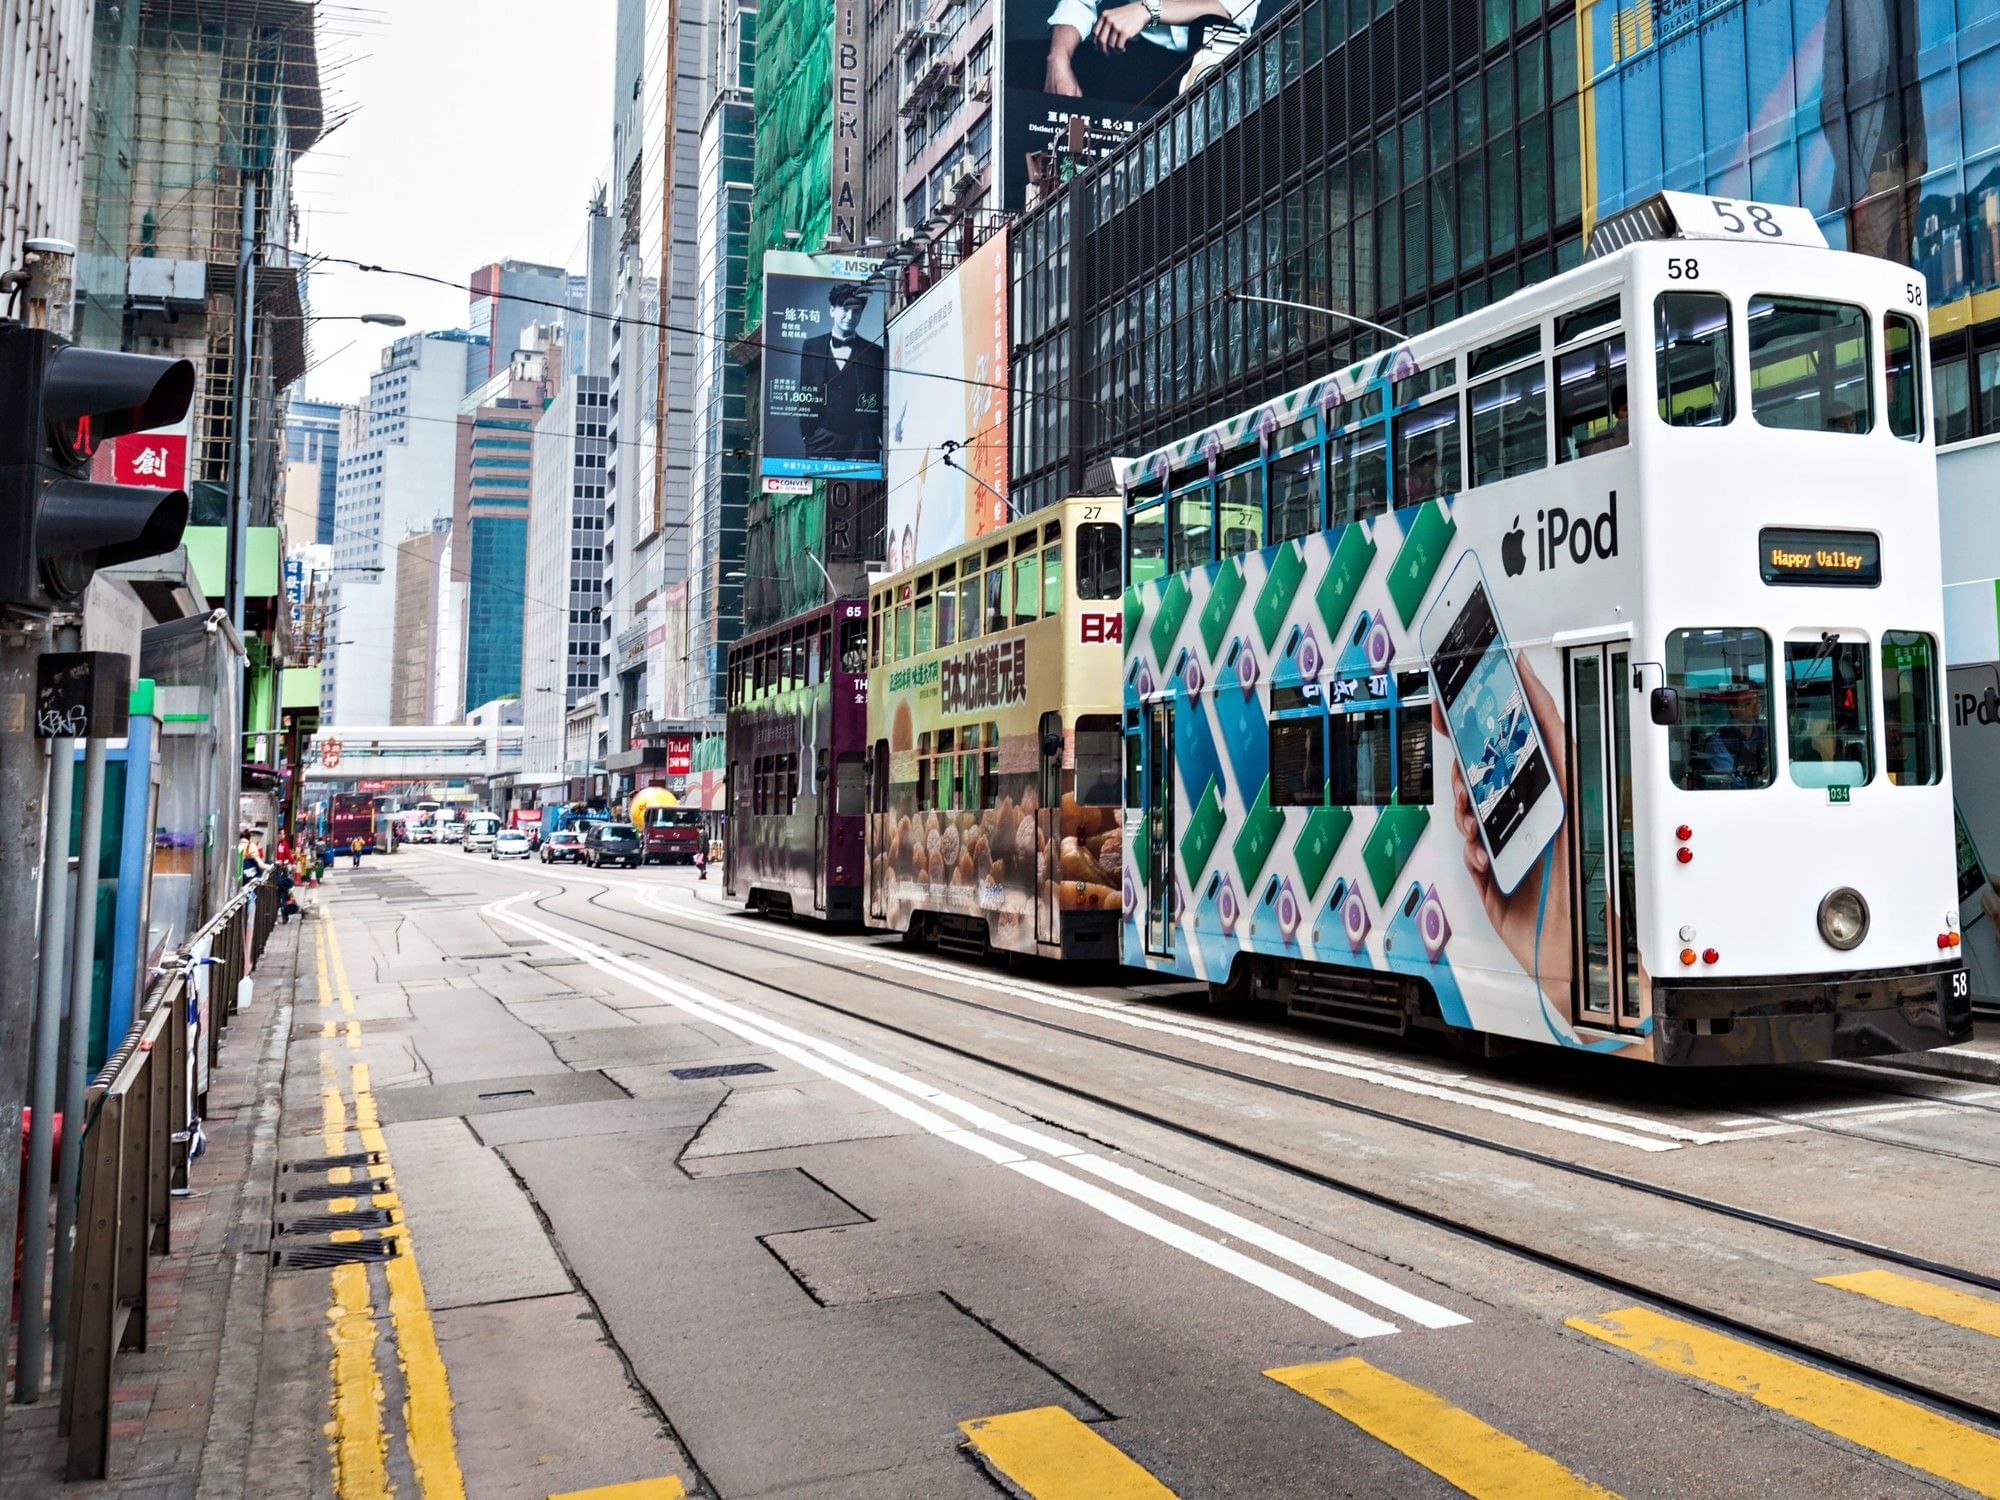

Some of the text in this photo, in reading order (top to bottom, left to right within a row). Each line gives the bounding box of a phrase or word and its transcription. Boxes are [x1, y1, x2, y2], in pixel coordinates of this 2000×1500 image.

[835, 0, 858, 243] IBERIAN
[1711, 200, 1783, 237] 58
[1667, 259, 1699, 280] 58
[1906, 283, 1923, 306] 58
[131, 447, 168, 488] 創
[1084, 506, 1102, 520] 27
[1239, 513, 1253, 526] 27
[1537, 490, 1618, 572] iPod
[1771, 549, 1862, 570] Happy Valley
[846, 607, 862, 617] 65
[853, 679, 868, 690] TH
[854, 694, 868, 703] 全
[1830, 787, 1849, 801] 034
[1953, 972, 1968, 998] 58
